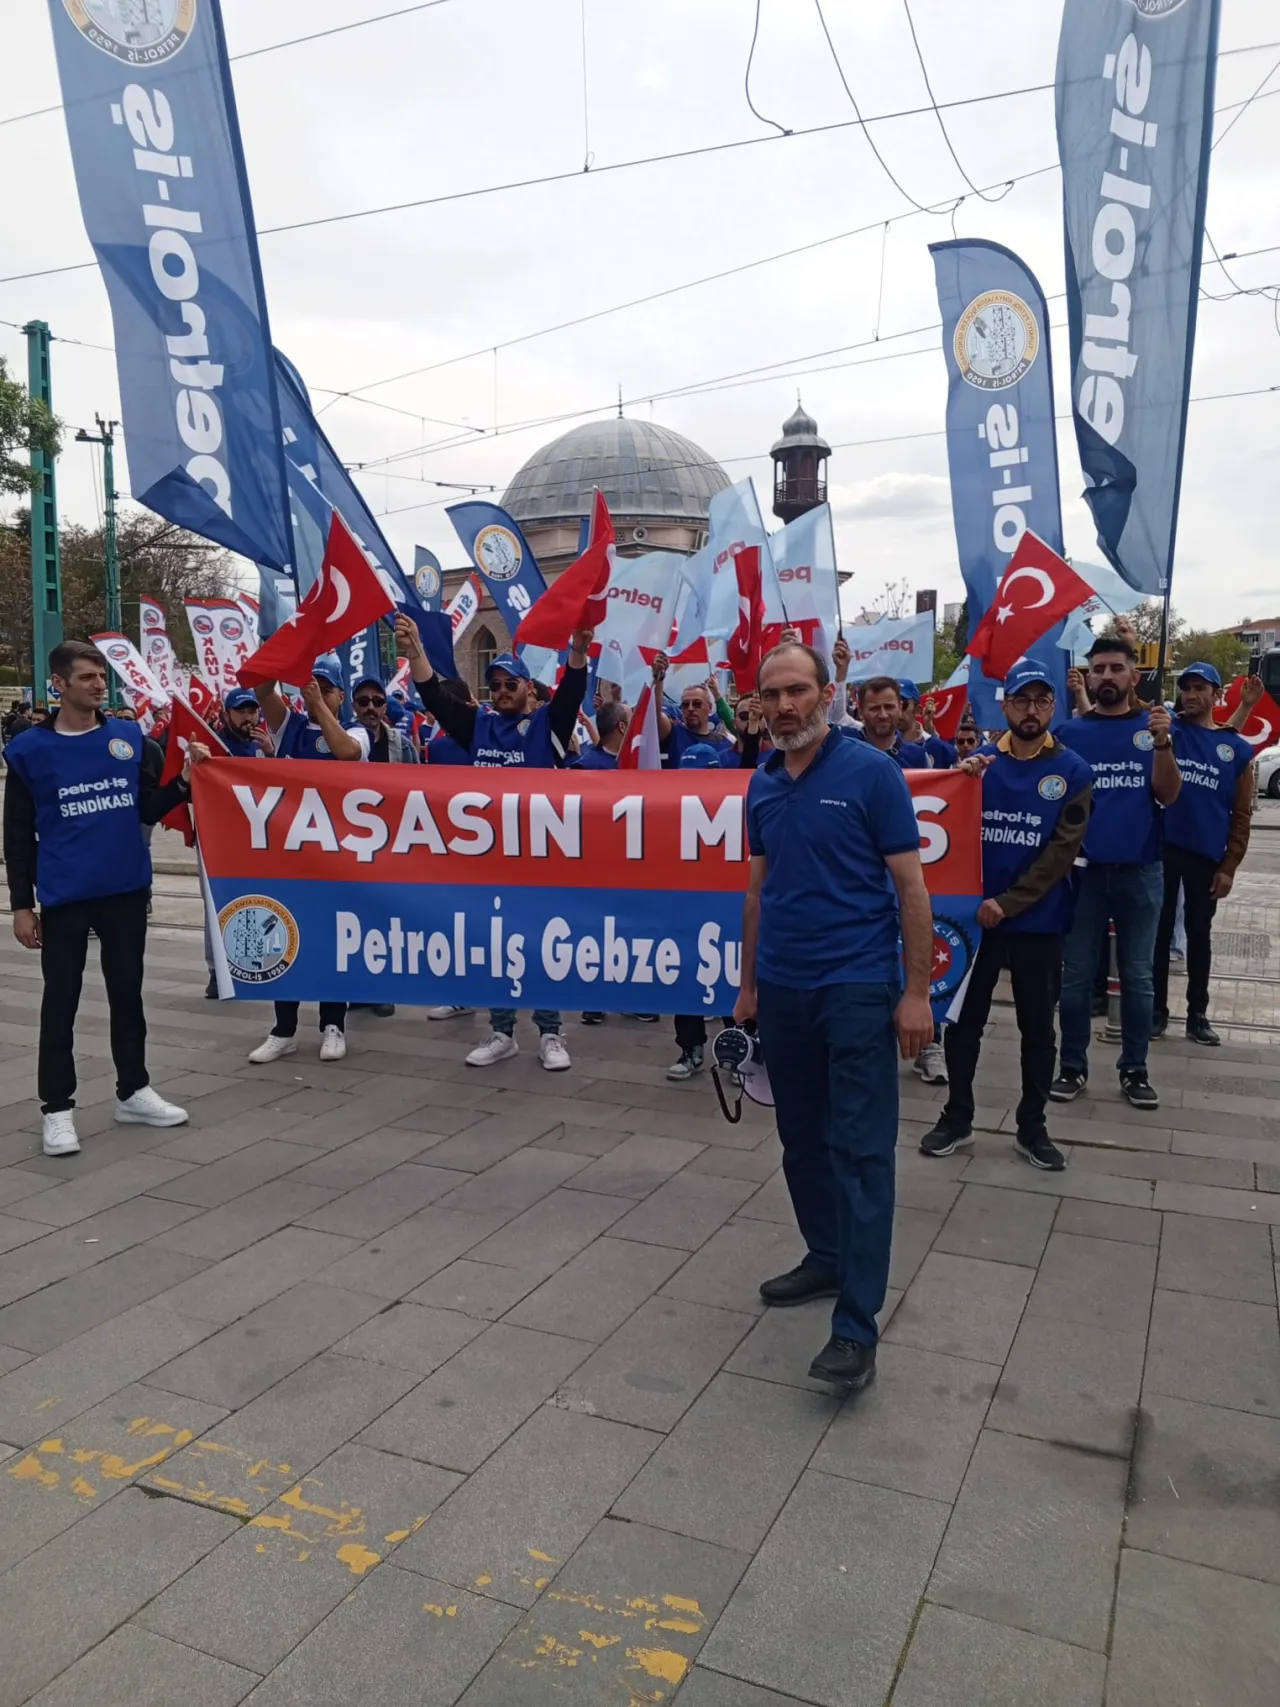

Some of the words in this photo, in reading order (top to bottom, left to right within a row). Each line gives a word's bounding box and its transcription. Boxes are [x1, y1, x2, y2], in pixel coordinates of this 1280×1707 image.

[58, 777, 129, 800] petrol-iş
[60, 792, 135, 818] SENDİKASI
[231, 784, 583, 863] YAŞASIN
[612, 794, 645, 861] 1
[981, 809, 1042, 828] etrol-iş
[980, 826, 1042, 848] ENDİKASI
[335, 895, 526, 999] Petrol-İş
[541, 915, 681, 986] Gebze
[267, 963, 286, 978] 1950
